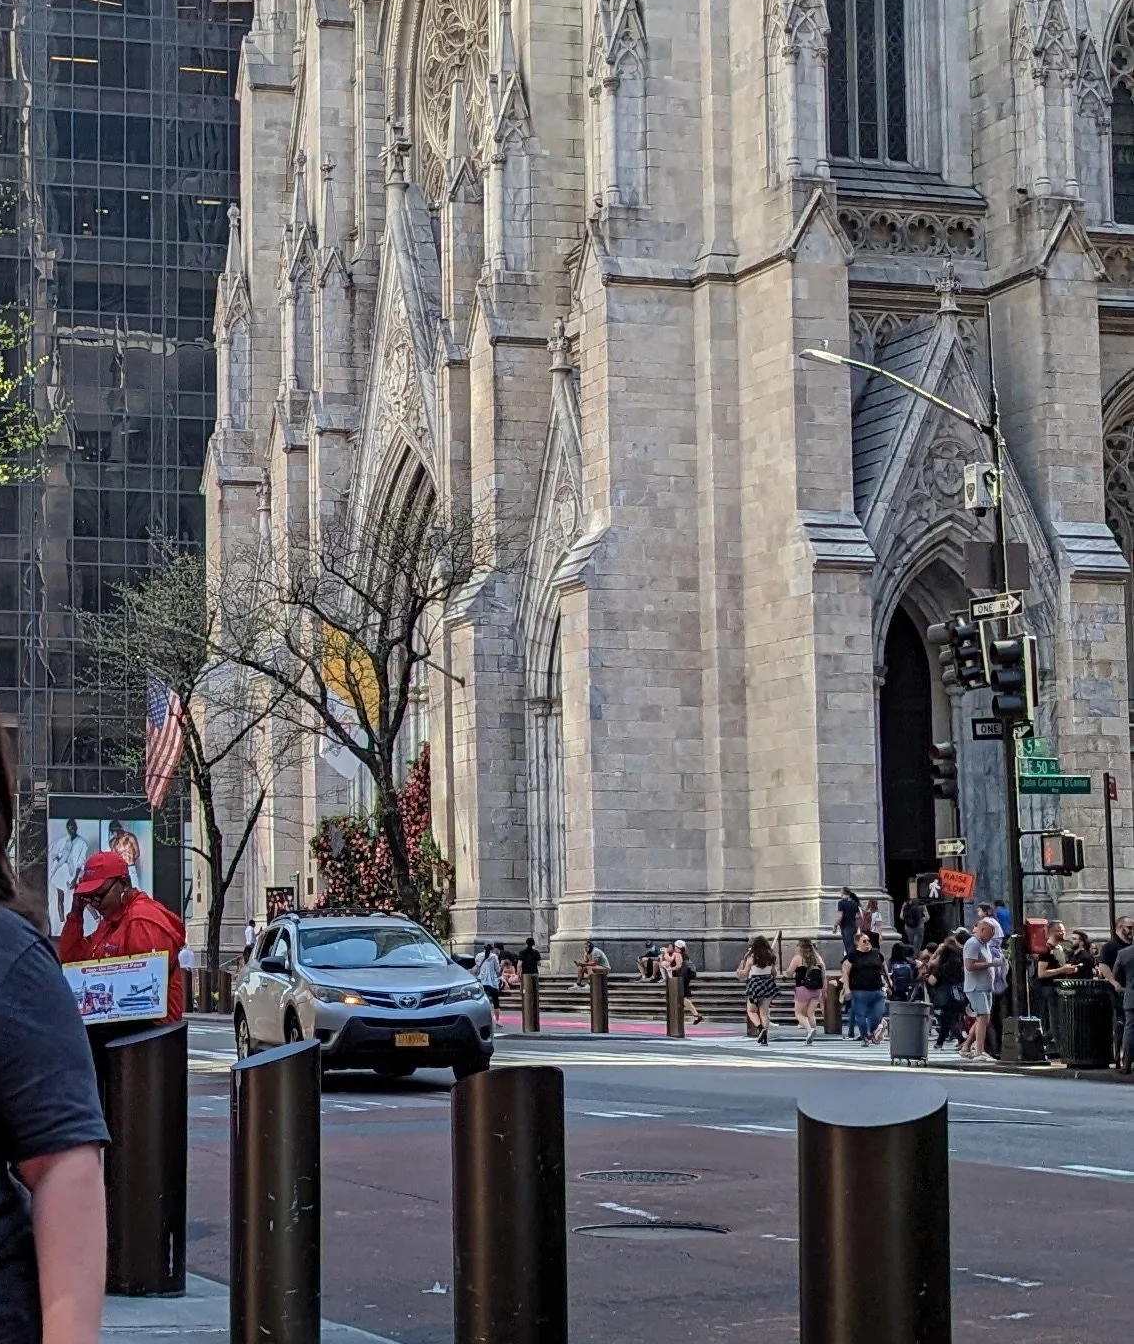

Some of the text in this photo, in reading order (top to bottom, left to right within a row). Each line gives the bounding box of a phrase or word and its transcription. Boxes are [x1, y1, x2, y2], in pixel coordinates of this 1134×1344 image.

[977, 599, 1016, 614] ONE WAY
[981, 724, 999, 734] ONE
[1036, 760, 1048, 774] 50
[1022, 777, 1037, 788] John
[1038, 777, 1063, 788] Cardinal
[943, 872, 968, 884] RAISE
